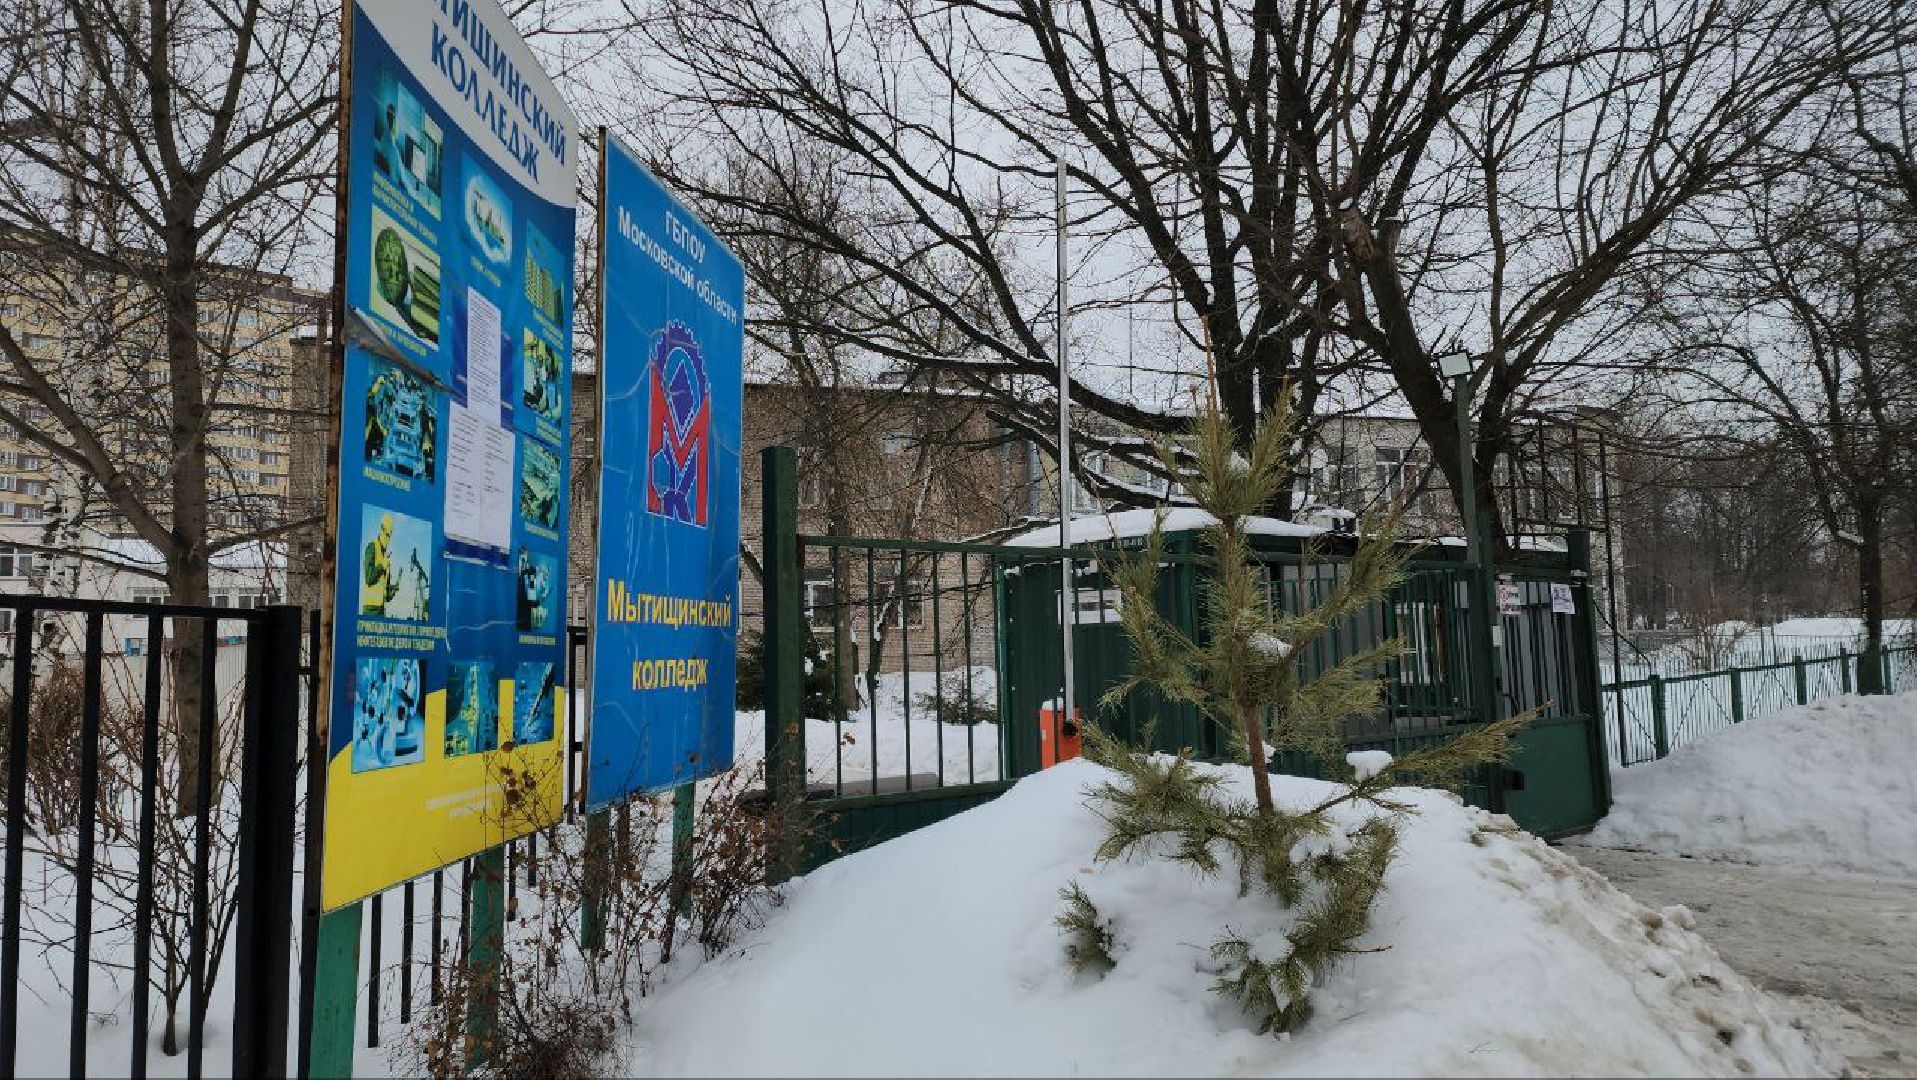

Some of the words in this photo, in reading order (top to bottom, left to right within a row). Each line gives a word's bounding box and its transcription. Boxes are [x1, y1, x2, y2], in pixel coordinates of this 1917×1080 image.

[432, 22, 539, 184] КОЛЛЕДЖ
[665, 210, 705, 263] ГБПОУ
[619, 205, 694, 290] Московской
[697, 280, 737, 326] области
[608, 578, 731, 630] Мытищинский
[632, 658, 708, 692] колледж
